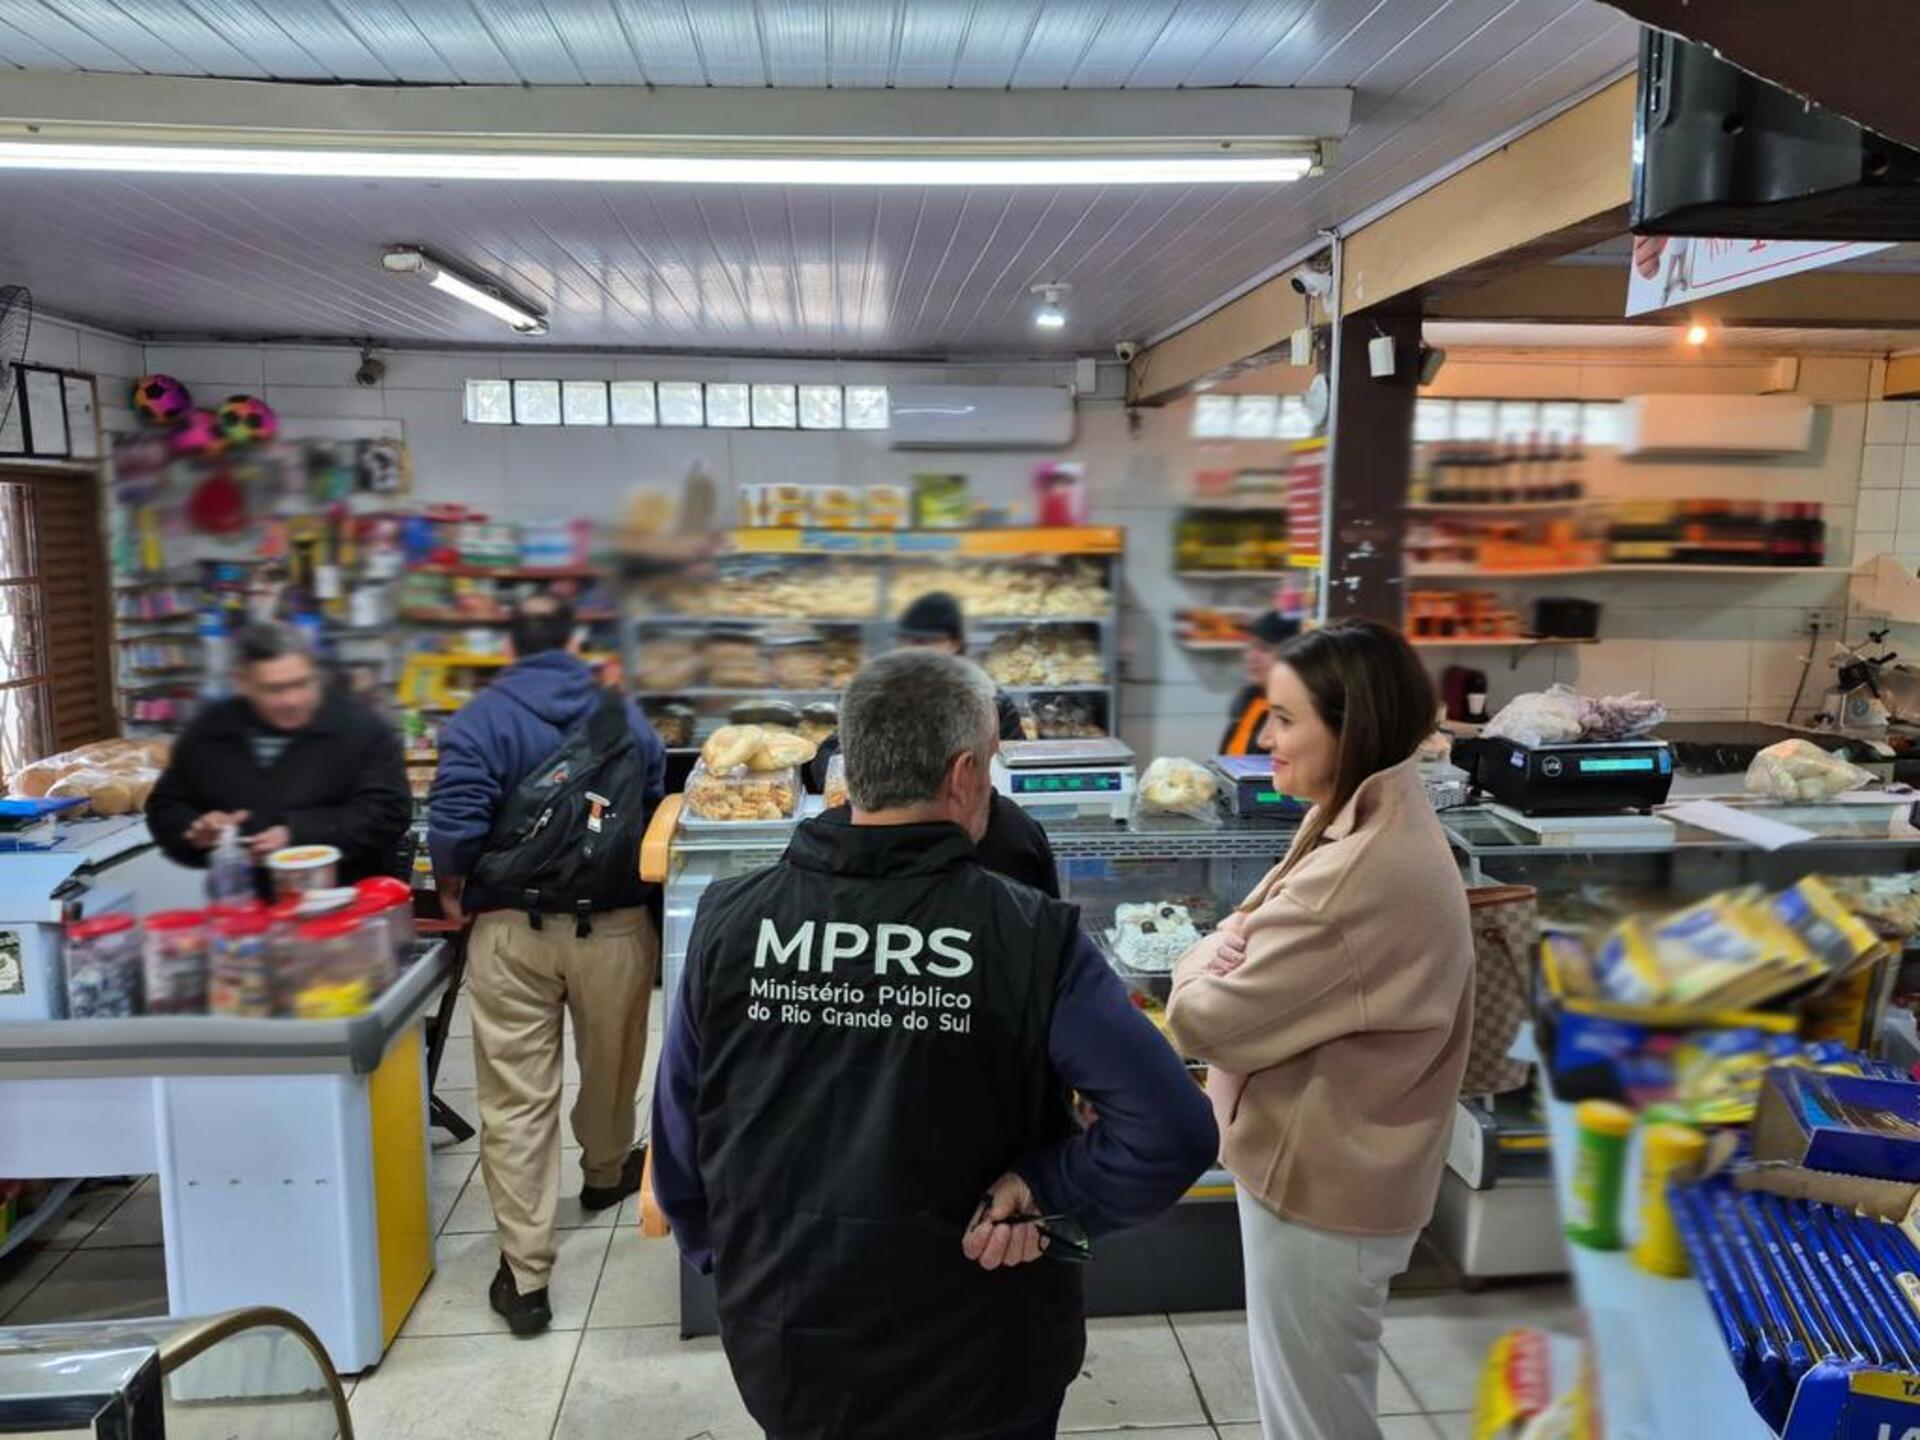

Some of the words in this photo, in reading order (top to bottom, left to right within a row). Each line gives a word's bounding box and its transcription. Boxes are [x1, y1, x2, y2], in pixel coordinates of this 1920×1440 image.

[753, 917, 974, 978] MPRS
[750, 977, 865, 1005] Ministério
[878, 984, 972, 1010] Público
[747, 1000, 771, 1021] do
[781, 1003, 812, 1024] Rio
[821, 1006, 893, 1029] Grande
[902, 1010, 929, 1031] do
[939, 1012, 971, 1034] Sul
